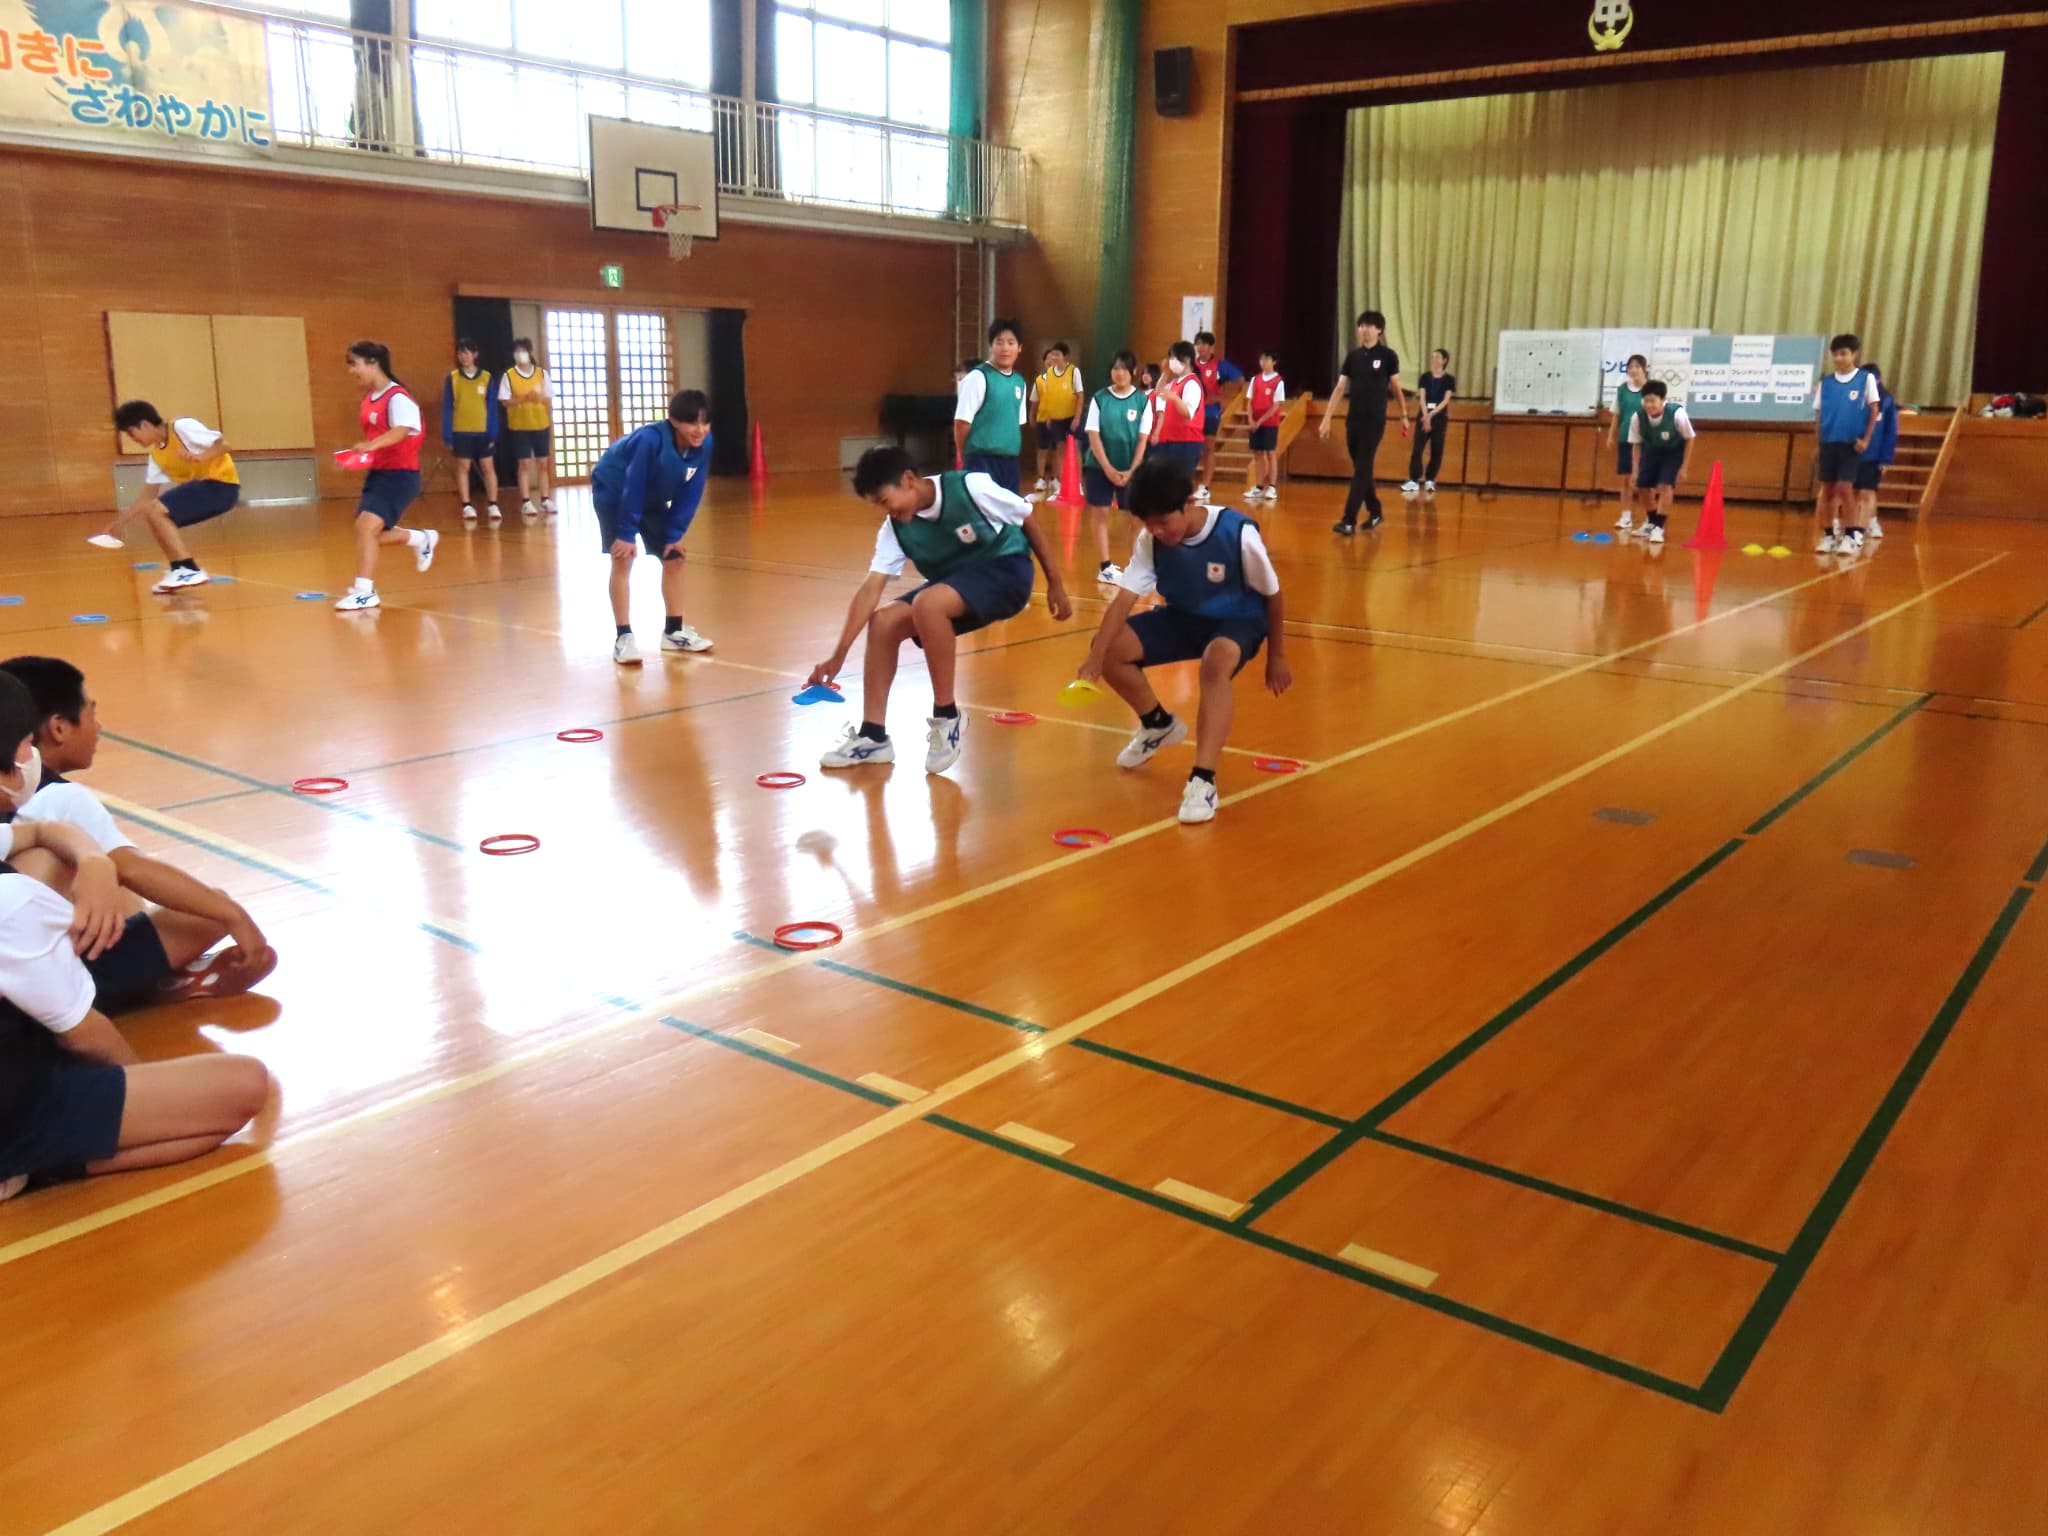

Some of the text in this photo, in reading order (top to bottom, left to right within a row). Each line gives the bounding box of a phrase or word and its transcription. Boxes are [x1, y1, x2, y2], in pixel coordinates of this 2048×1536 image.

[67, 83, 270, 147] さわやかに
